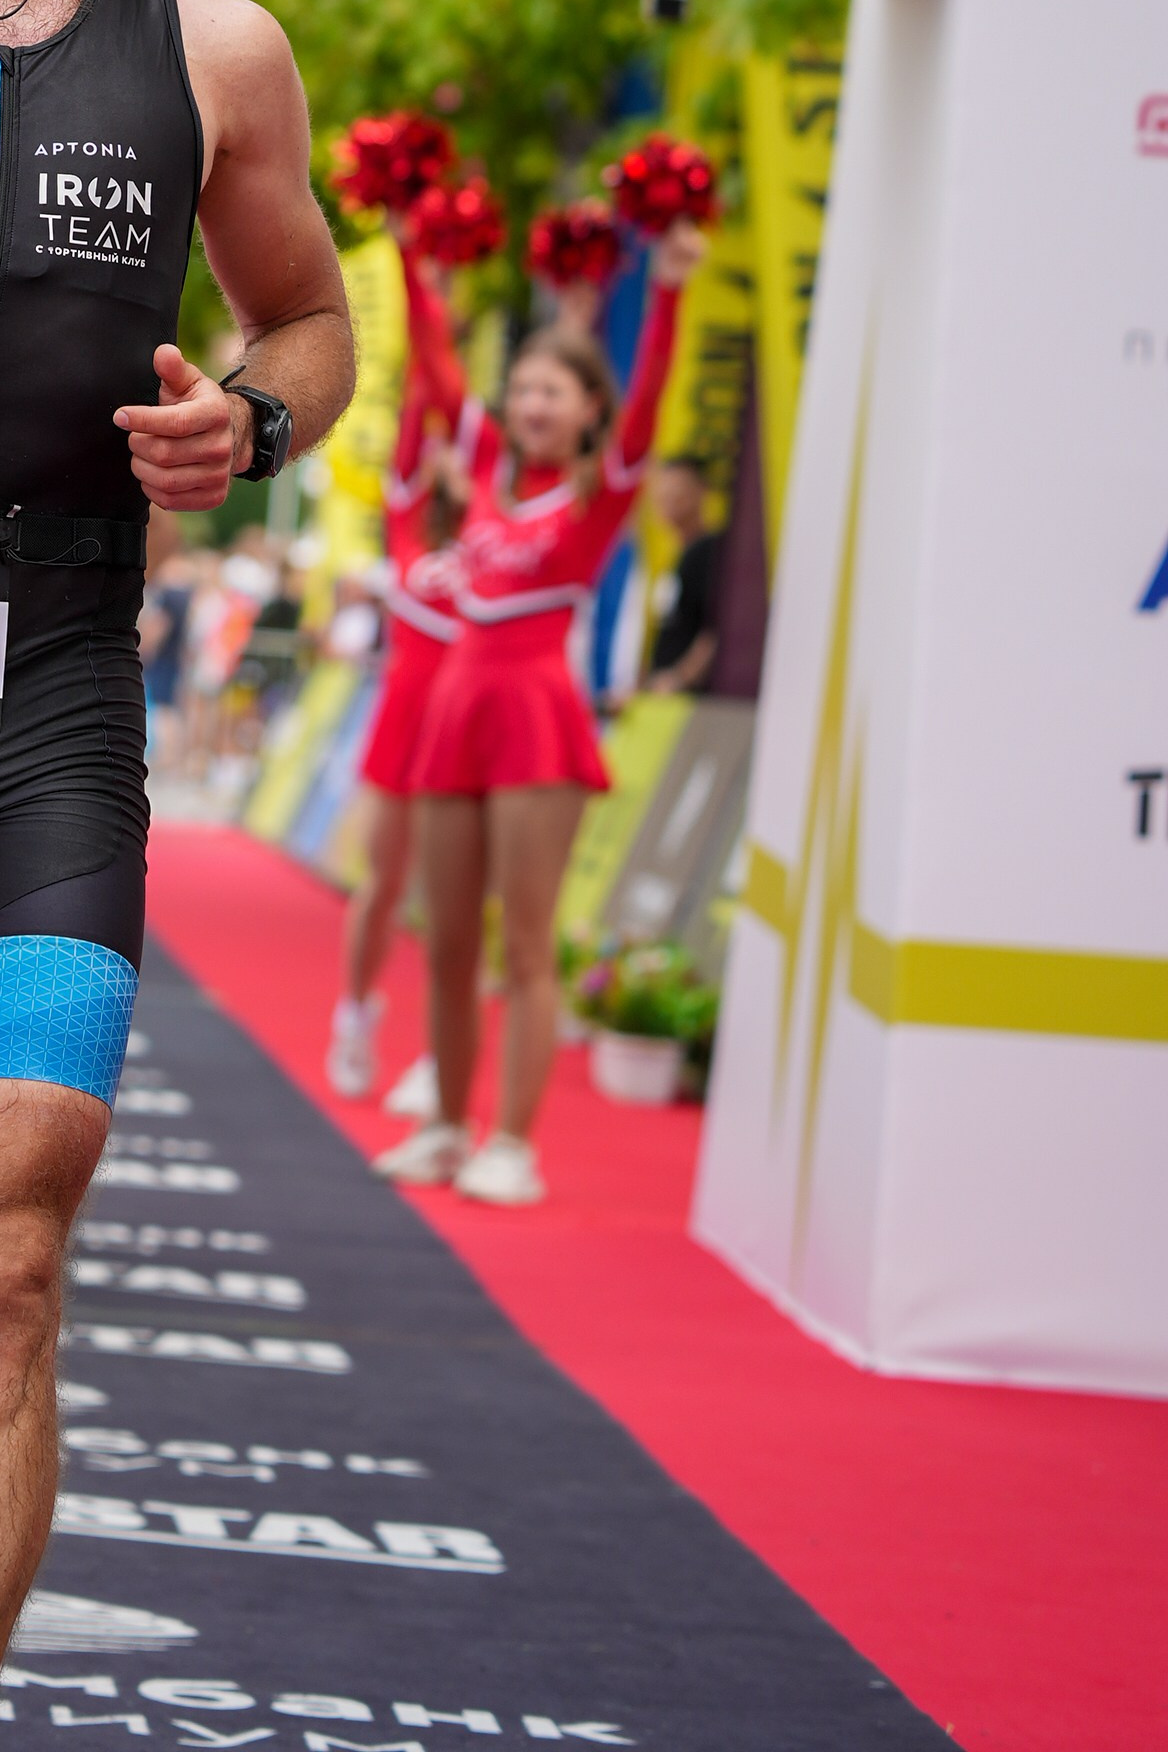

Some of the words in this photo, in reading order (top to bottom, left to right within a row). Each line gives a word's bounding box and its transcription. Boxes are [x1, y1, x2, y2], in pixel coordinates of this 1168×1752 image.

[34, 142, 137, 161] APTONIA
[38, 172, 152, 215] IRON
[39, 213, 151, 254] TEAM
[122, 256, 146, 268] КЛУБ
